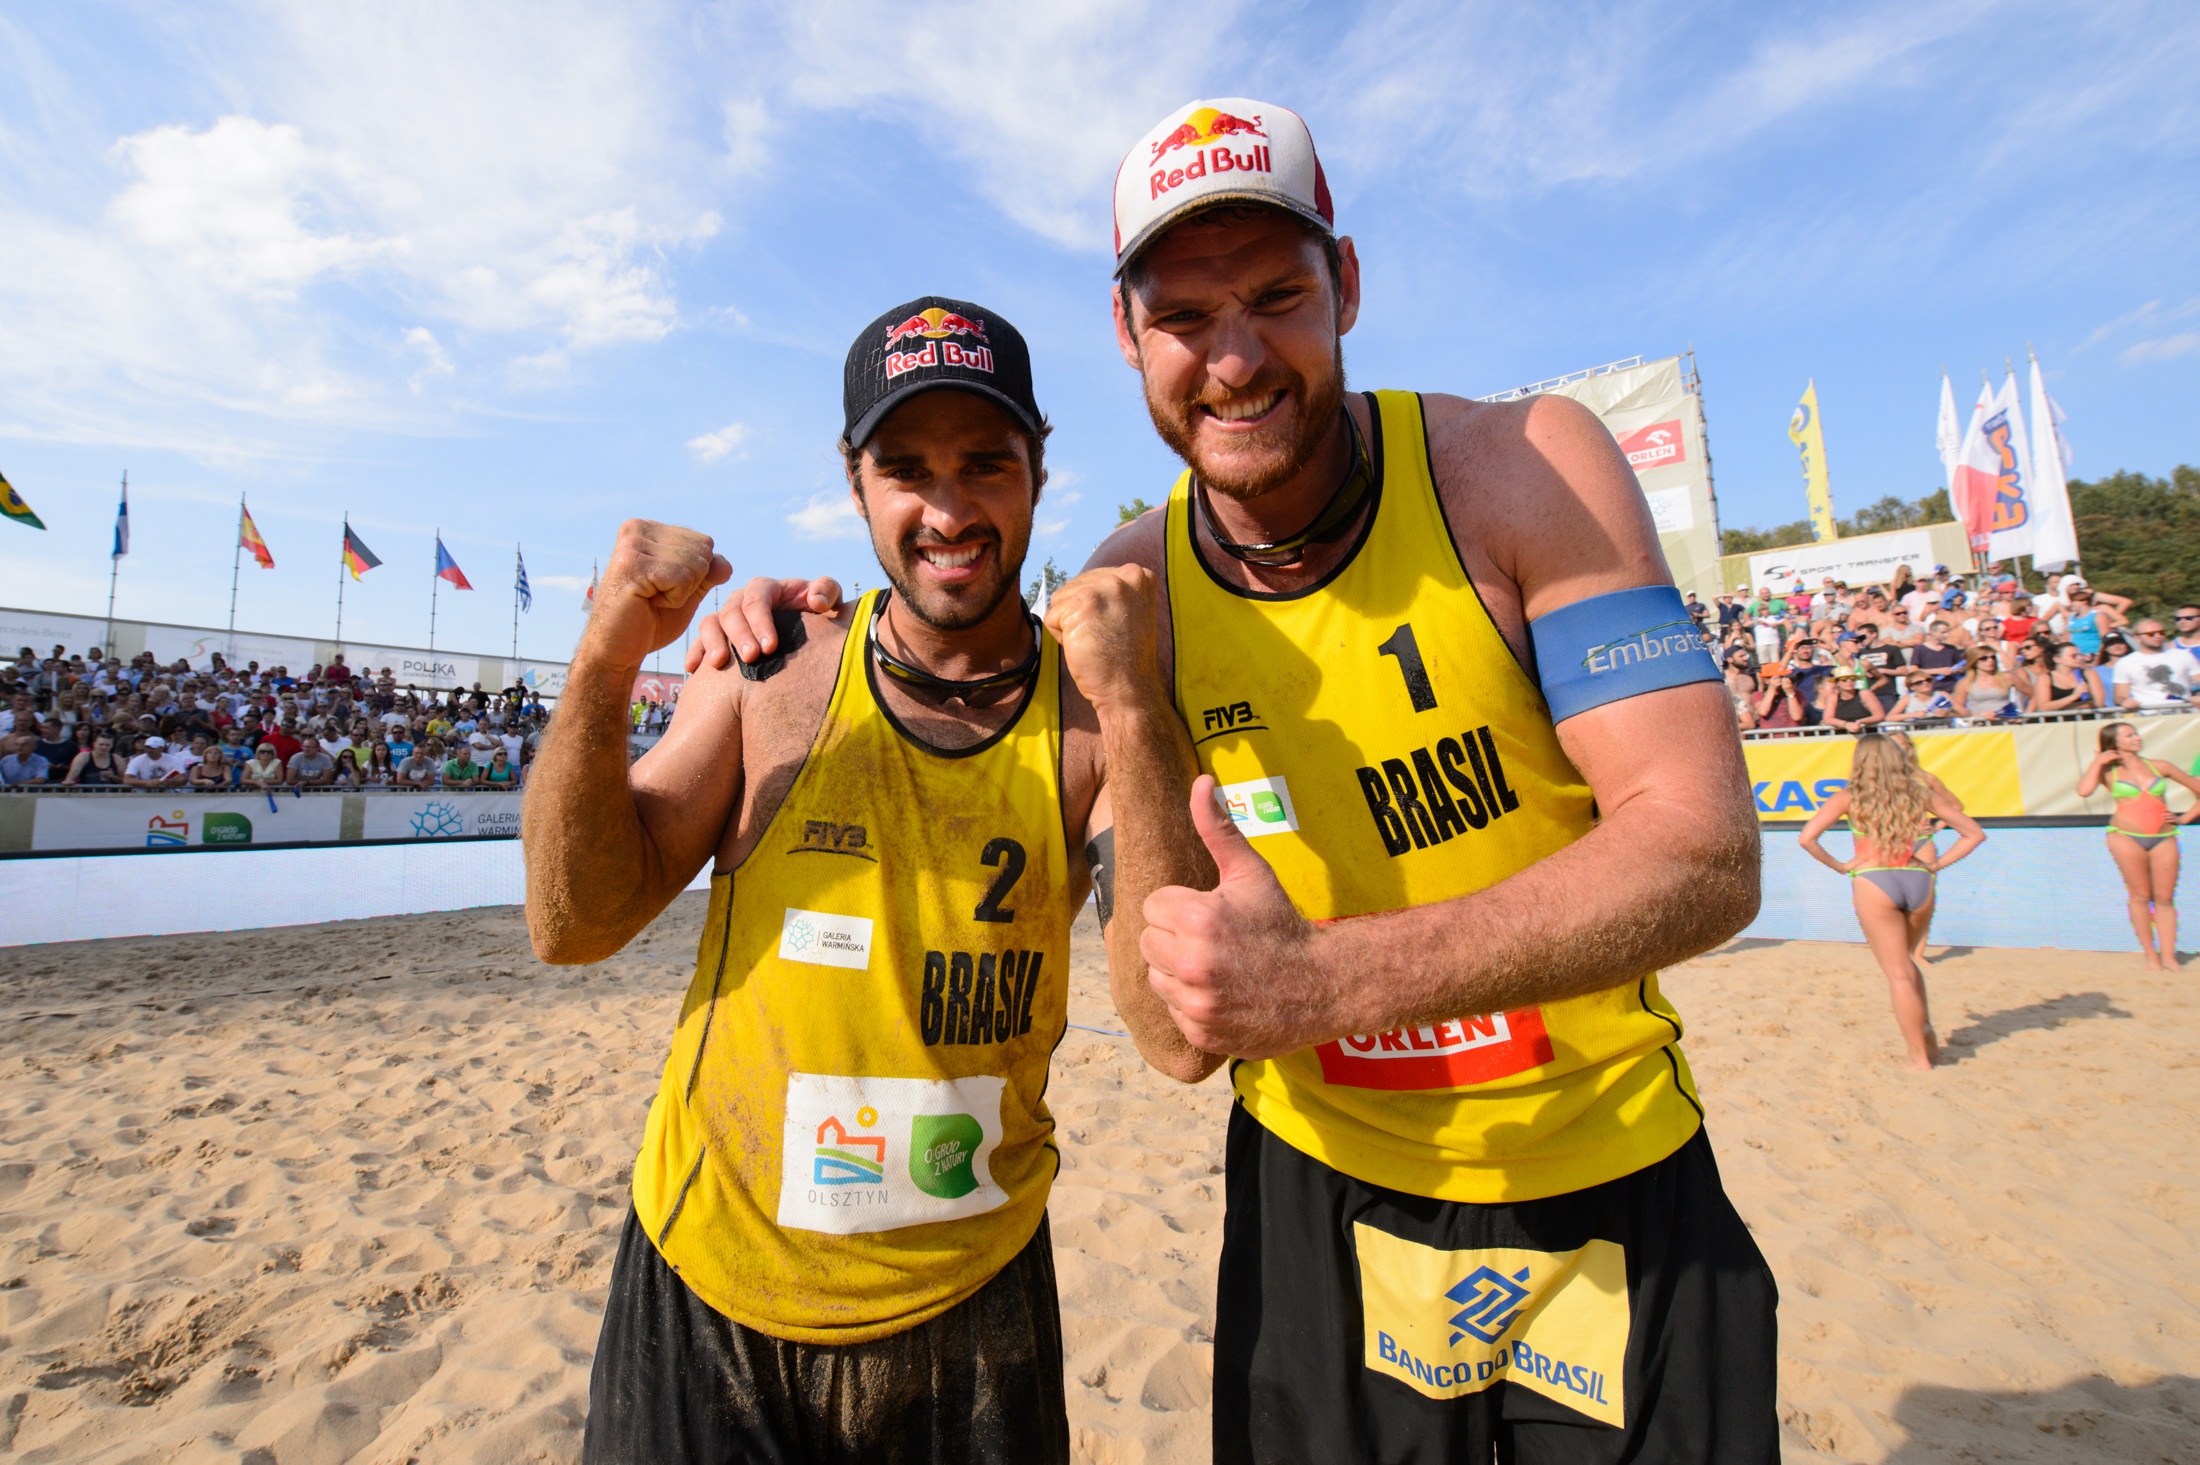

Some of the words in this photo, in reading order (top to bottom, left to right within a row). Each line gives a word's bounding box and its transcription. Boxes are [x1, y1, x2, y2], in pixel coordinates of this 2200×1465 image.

[1150, 150, 1206, 200] Red
[1210, 145, 1271, 173] Bull
[886, 341, 938, 380] Red
[942, 341, 994, 374] Bull
[1630, 446, 1672, 462] ORLEN
[1800, 564, 1842, 576] SPORT
[403, 661, 456, 677] POLSKA
[1377, 622, 1438, 713] 1
[1355, 725, 1520, 858] BRASIL
[477, 813, 521, 824] GALERIA
[973, 837, 1027, 923] 2
[822, 940, 865, 952] WARMIŃSKA
[823, 931, 852, 941] GALERIA
[920, 949, 1044, 1046] BRASIL
[935, 1161, 941, 1176] Z
[941, 1150, 968, 1174] NATURY
[808, 1190, 888, 1207] OLSZTYN
[1378, 1330, 1472, 1388] BANCO
[1477, 1349, 1509, 1381] DO
[1511, 1340, 1608, 1406] BRASIL
